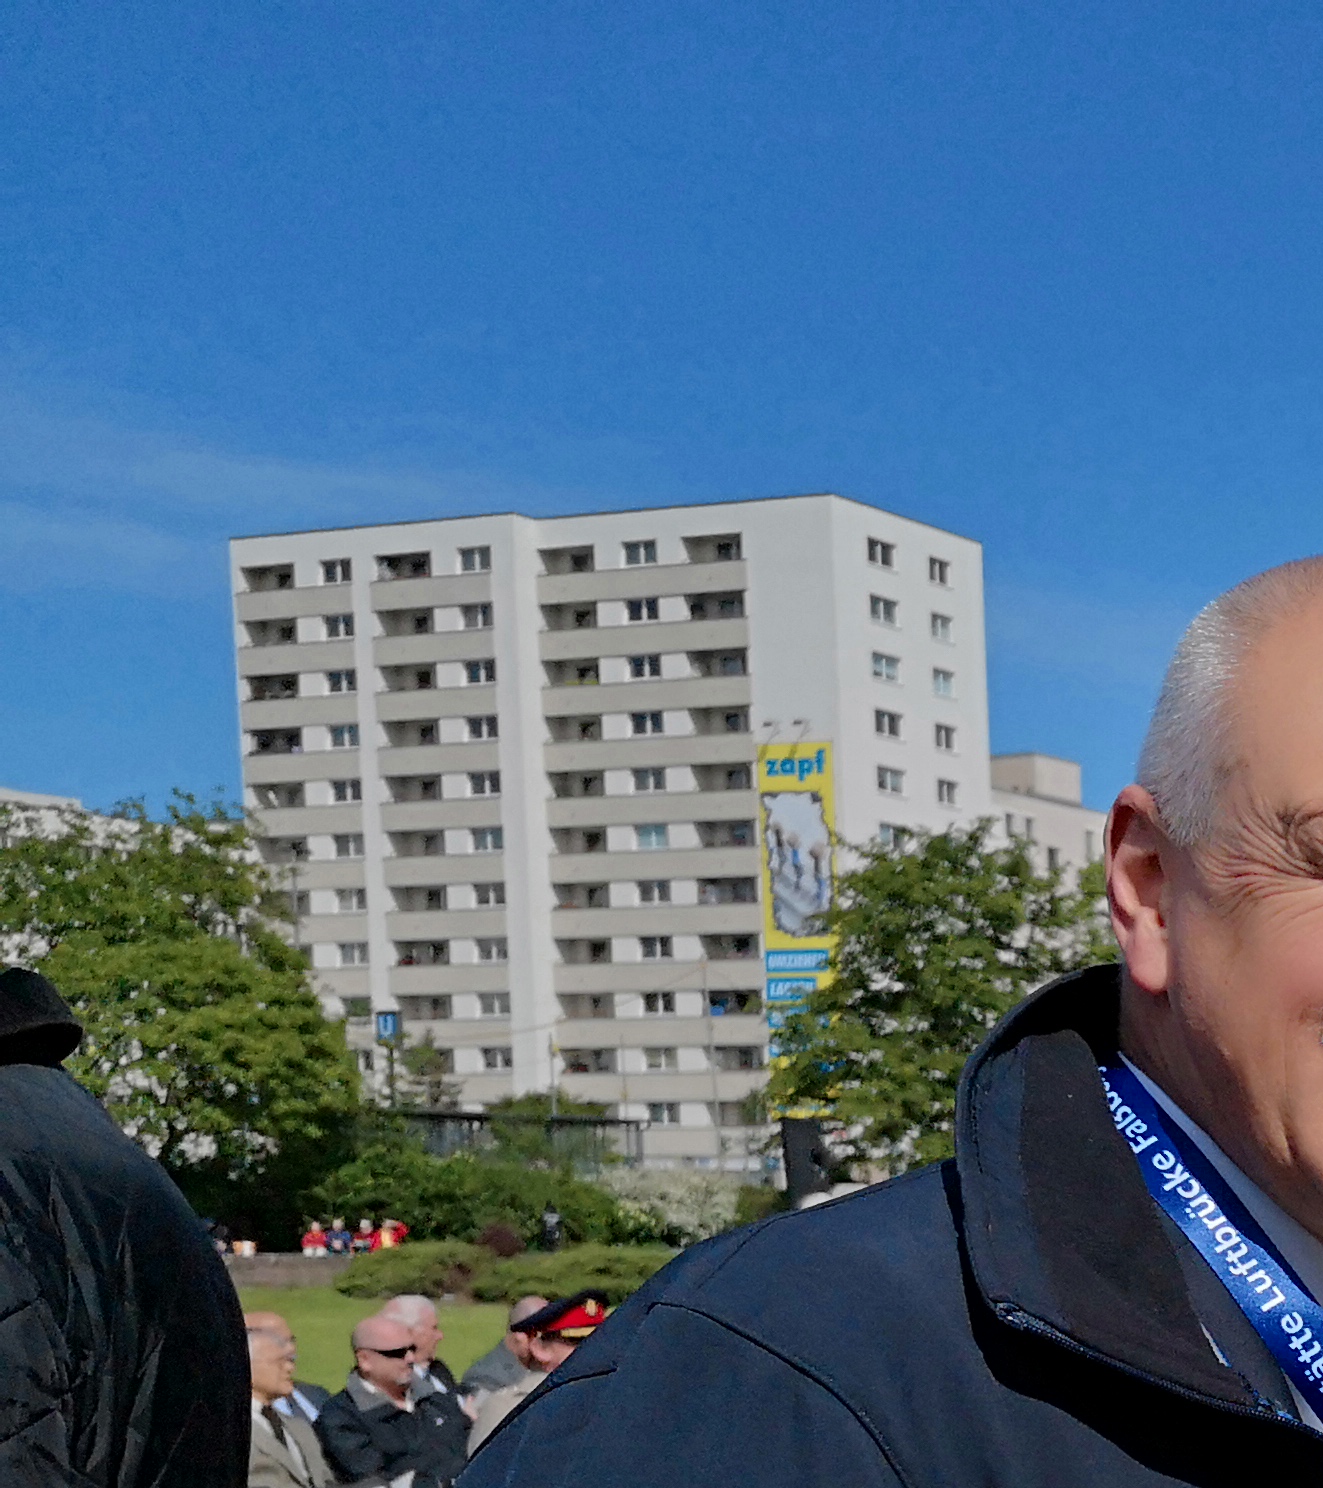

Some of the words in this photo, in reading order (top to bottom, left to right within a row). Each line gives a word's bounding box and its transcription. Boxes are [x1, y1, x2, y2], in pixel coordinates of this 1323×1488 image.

[766, 748, 826, 782] zapf
[379, 1015, 394, 1037] U
[1152, 1149, 1286, 1312] Luftbrücke
